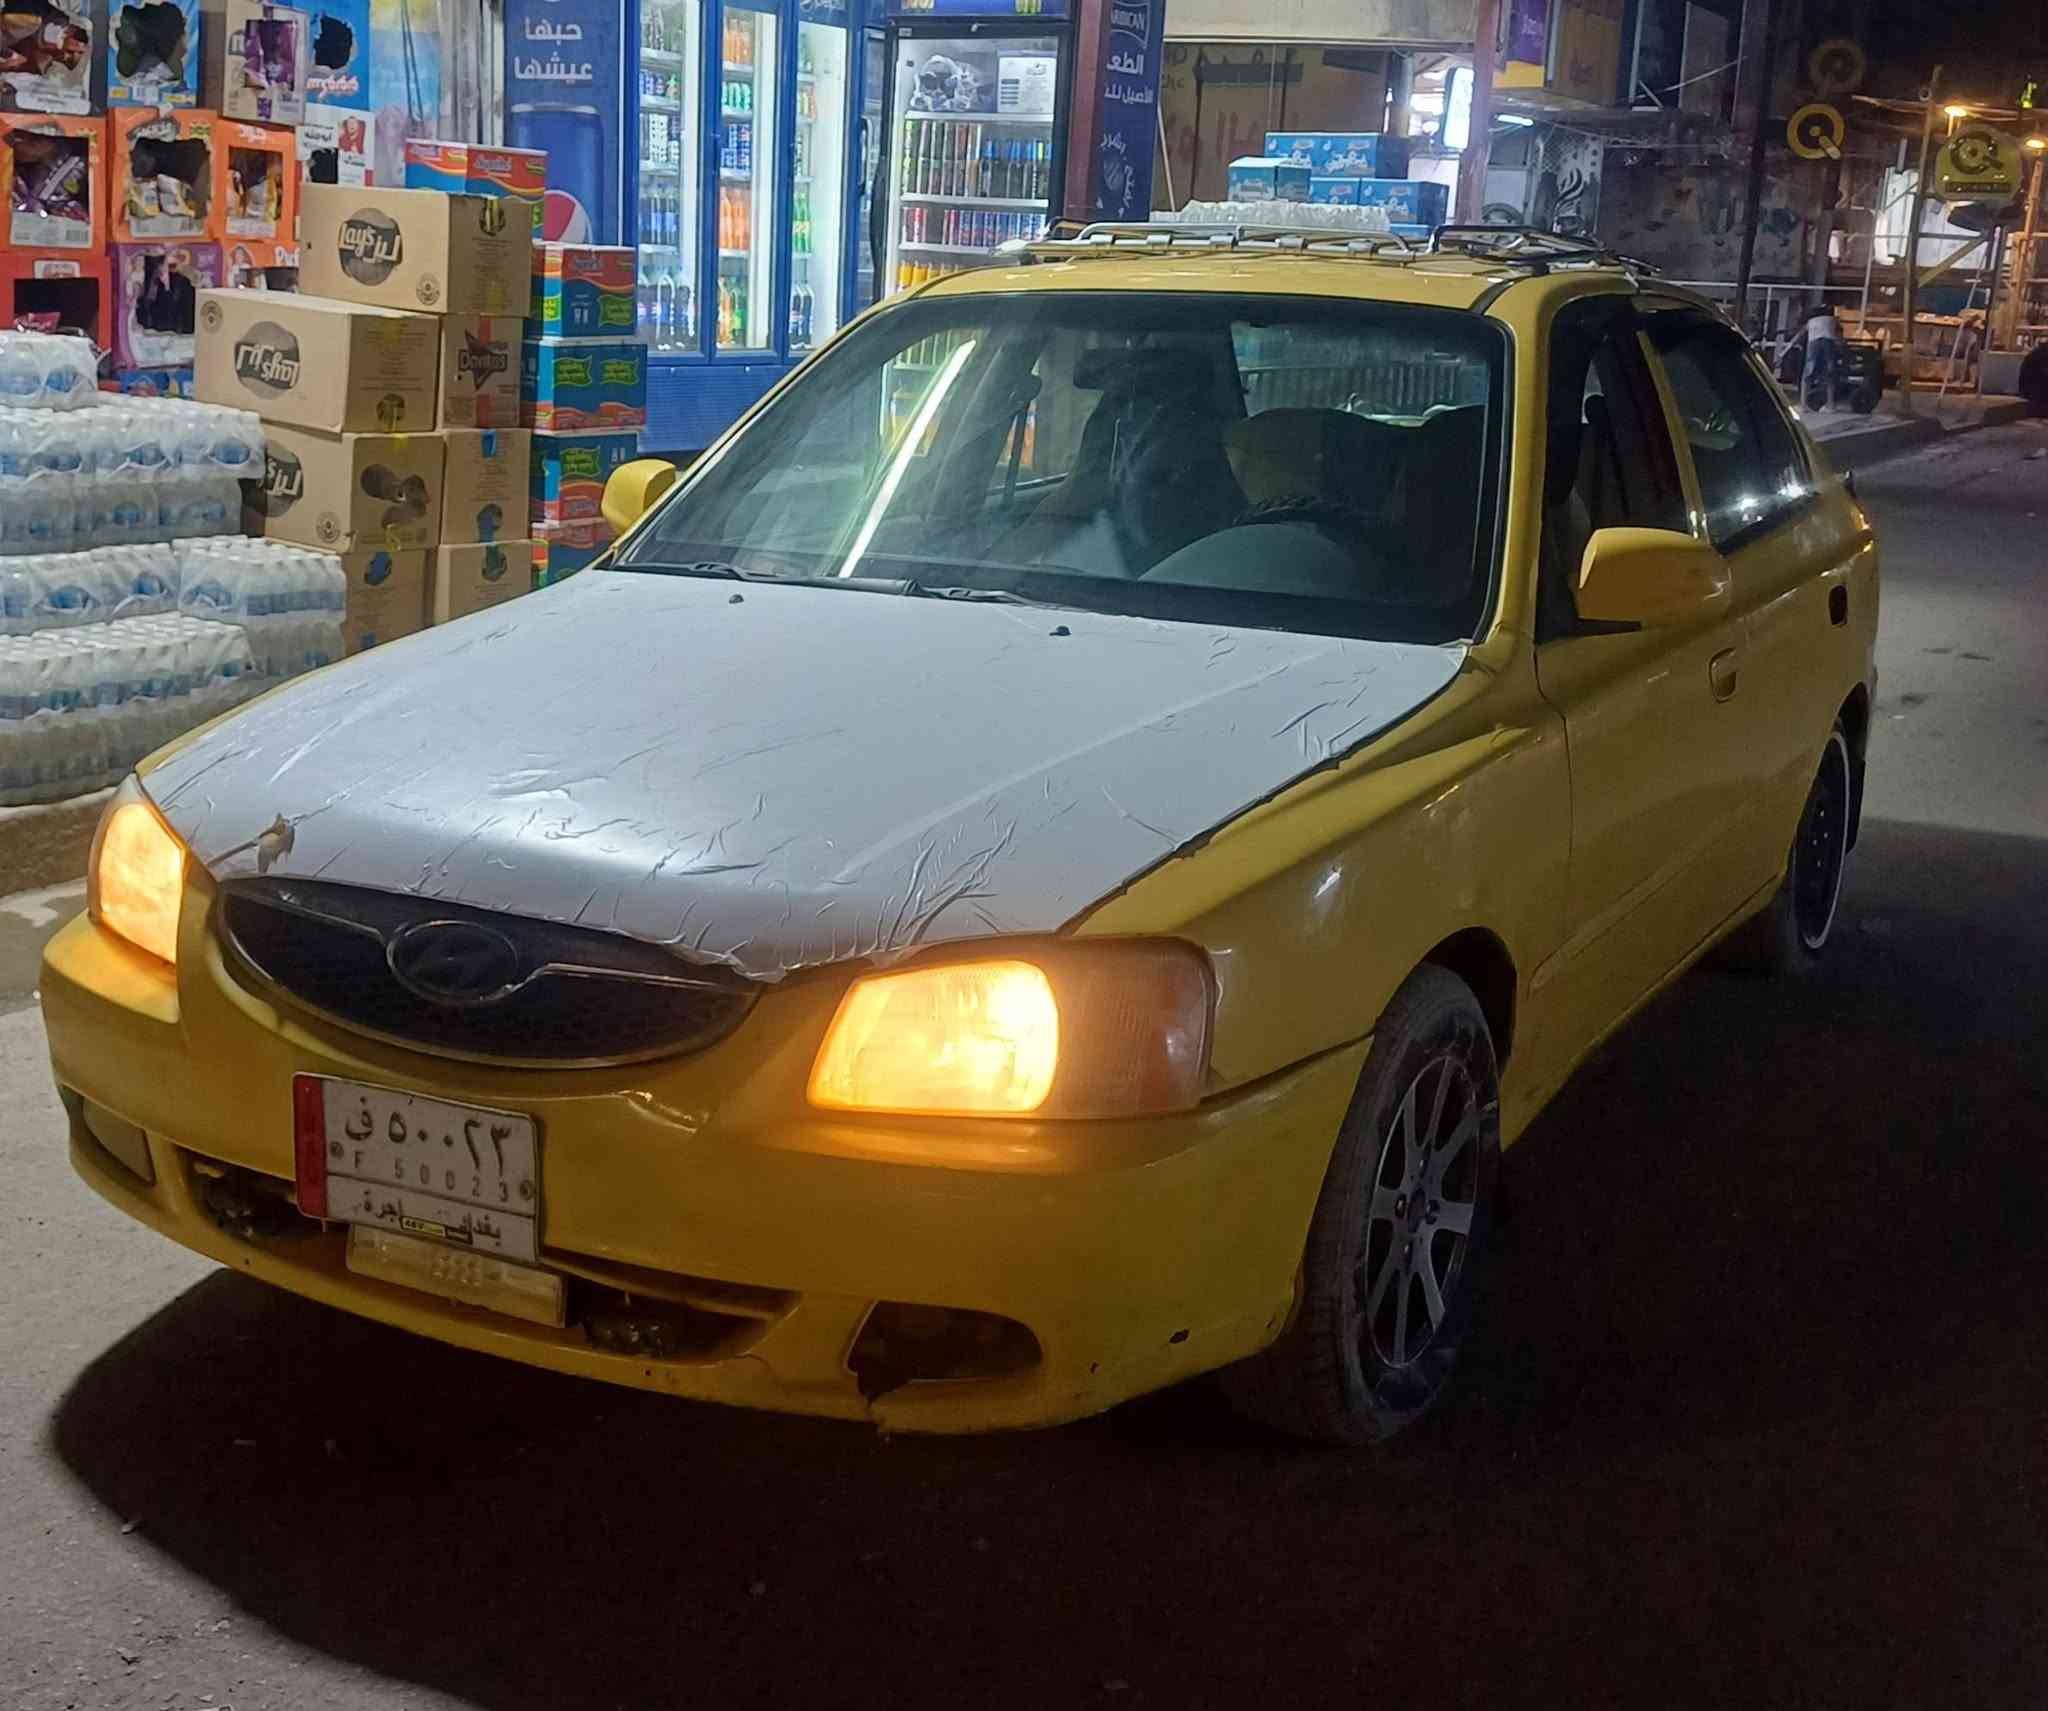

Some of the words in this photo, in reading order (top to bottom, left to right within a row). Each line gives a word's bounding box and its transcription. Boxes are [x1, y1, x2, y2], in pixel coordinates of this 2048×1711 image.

[525, 16, 583, 46] حبها
[514, 51, 592, 85] عيشها
[1106, 51, 1144, 75] الطع
[338, 221, 376, 257] Lay's
[363, 233, 402, 264] ليز
[260, 352, 300, 387] Lay's
[462, 354, 507, 371] Doritos
